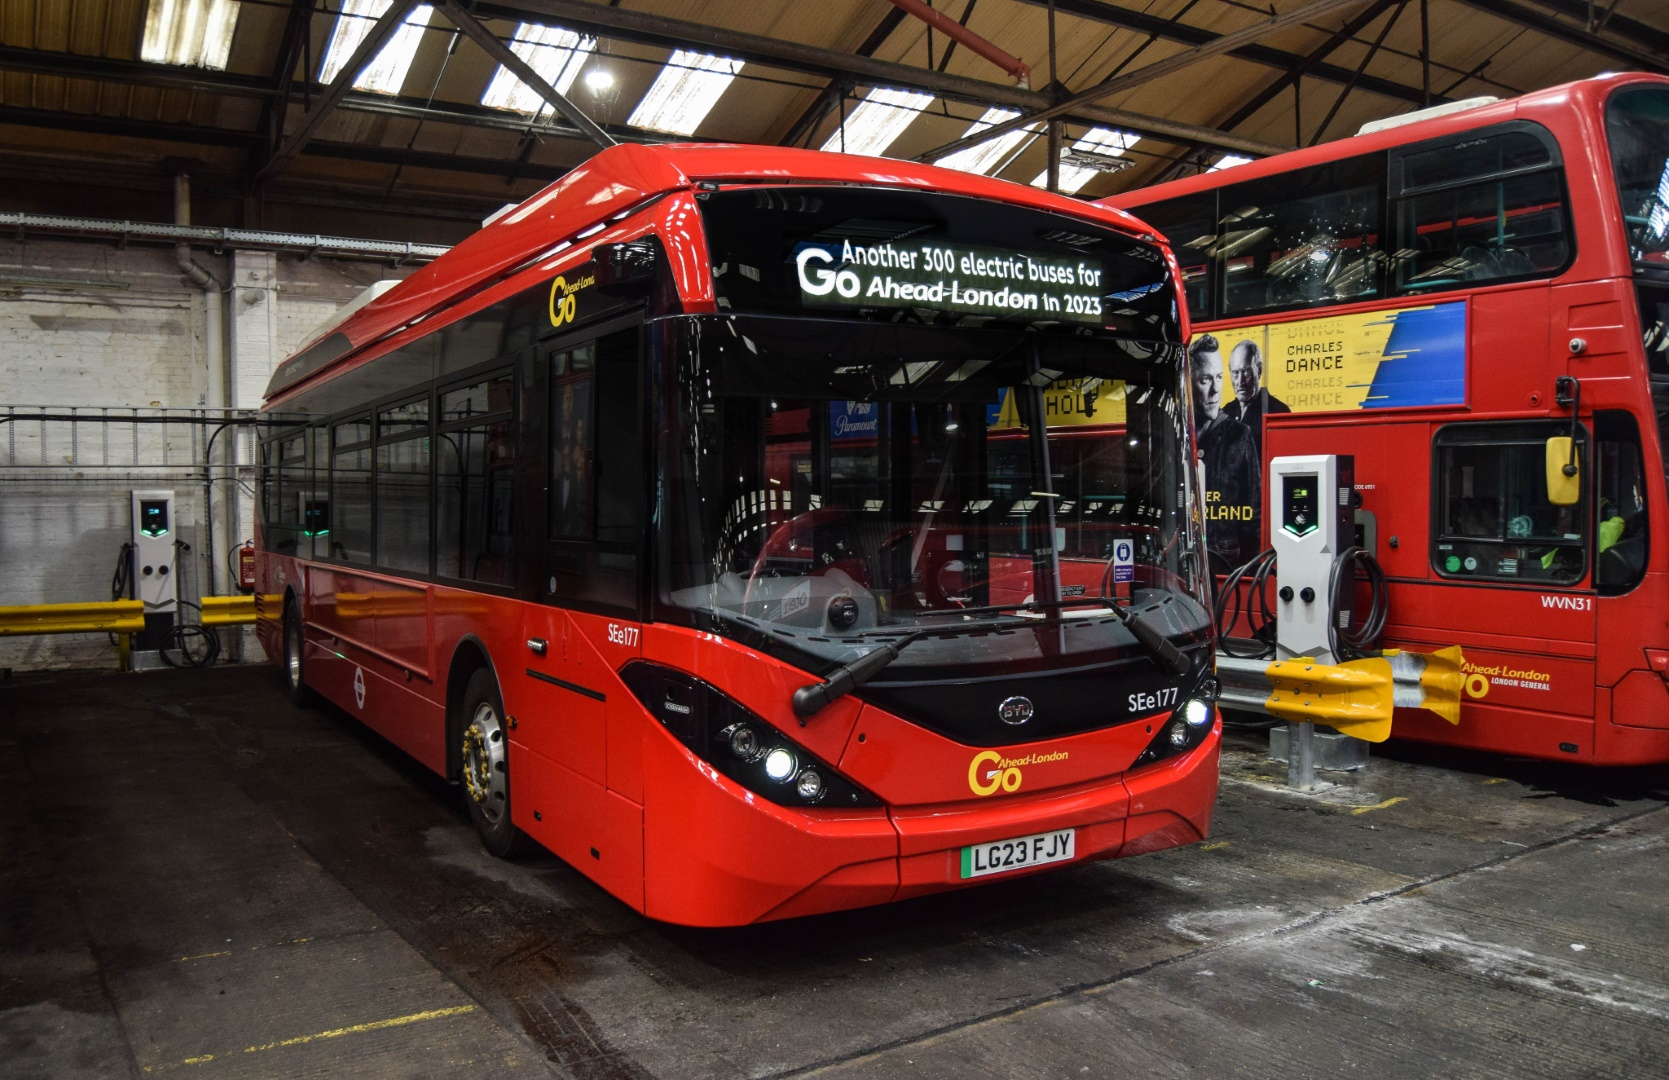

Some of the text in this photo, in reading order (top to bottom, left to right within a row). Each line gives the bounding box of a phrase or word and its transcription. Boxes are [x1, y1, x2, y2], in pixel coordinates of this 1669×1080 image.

[796, 247, 861, 299] Go
[841, 239, 1101, 287] Another 300 electric buses for
[549, 275, 577, 328] Go
[865, 276, 1102, 316] Ahead-London in 2023
[1287, 341, 1343, 356] CHARLES
[1286, 355, 1344, 373] DANCE
[1287, 376, 1343, 390] CHARLES
[1286, 392, 1344, 407] DANCE
[834, 414, 878, 436] Paramount
[1541, 595, 1591, 611] WVN31
[608, 622, 639, 647] SEe177
[1461, 662, 1551, 681] Ahead-London
[1491, 676, 1551, 691] LONDON GENERAL
[1128, 686, 1179, 712] SEe177
[1003, 703, 1031, 718] BYD
[997, 750, 1069, 769] Ahead-London
[968, 750, 1023, 797] Go
[975, 840, 1027, 872] LG23
[1033, 832, 1071, 861] FJY
